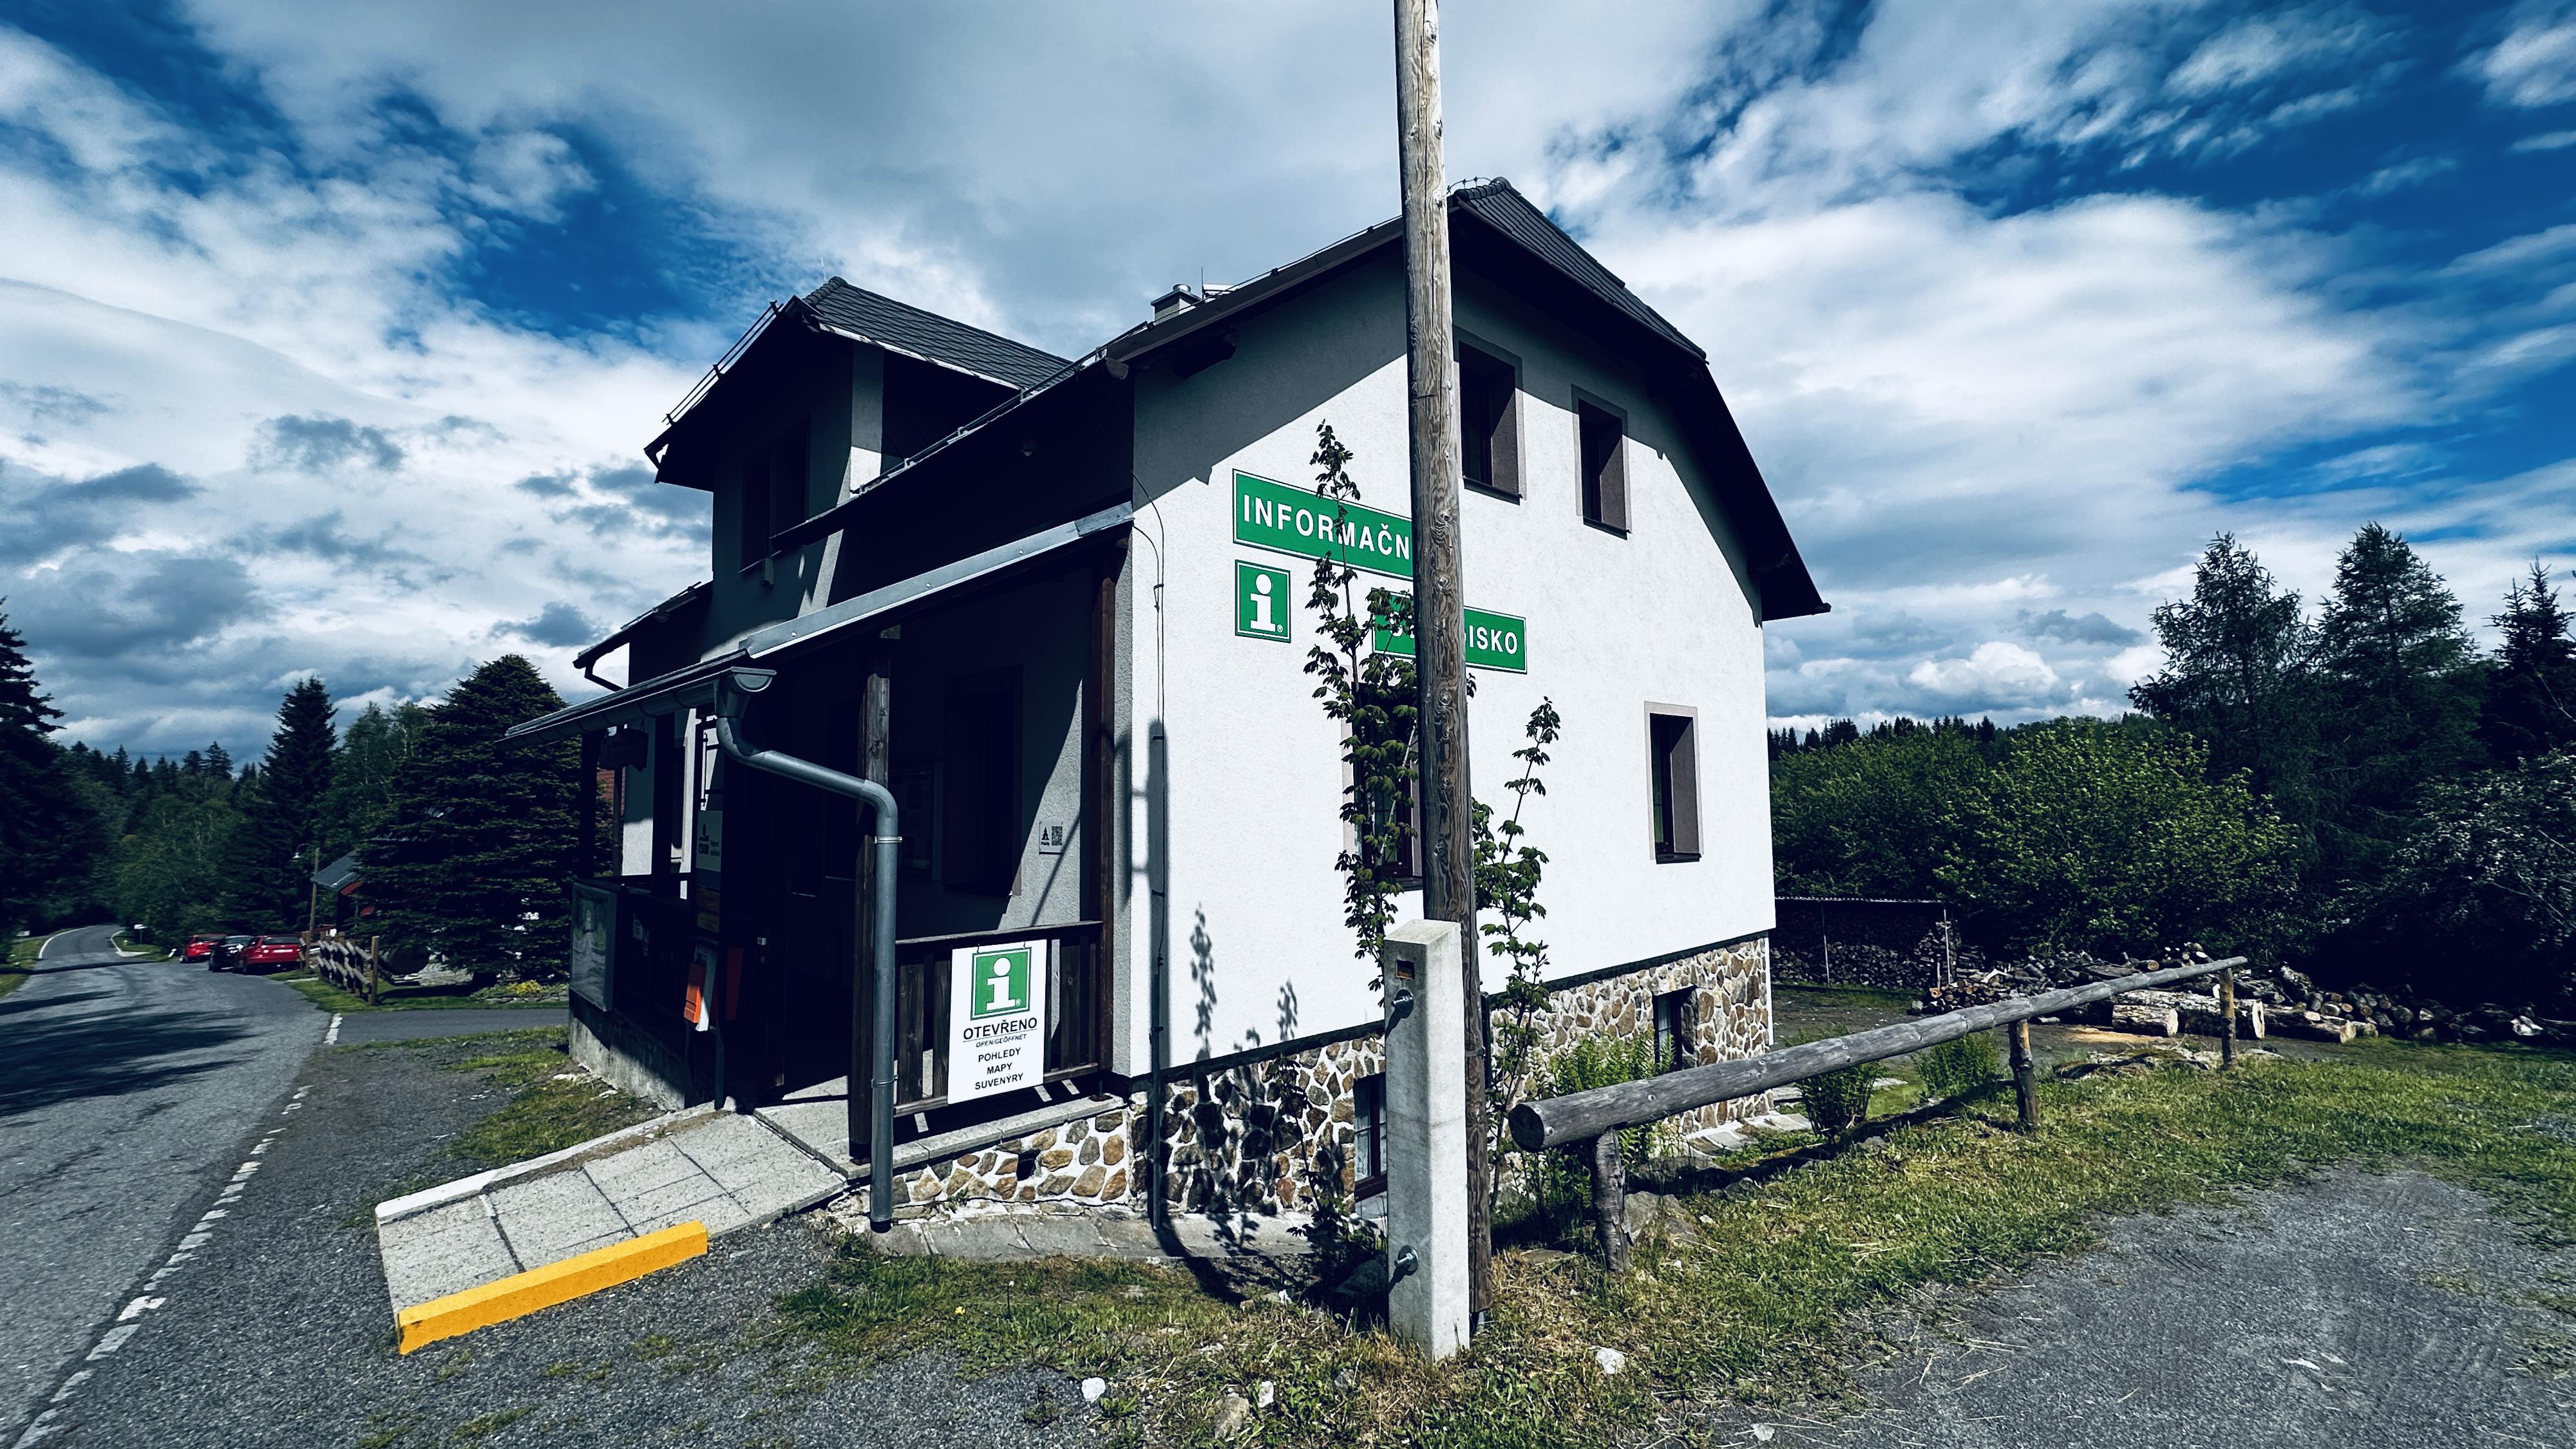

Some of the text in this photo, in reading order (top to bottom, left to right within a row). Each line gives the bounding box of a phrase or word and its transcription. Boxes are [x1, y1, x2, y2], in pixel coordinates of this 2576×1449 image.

[1244, 495, 1409, 560] INFORMAČN
[963, 1018, 1037, 1039] OTEVŘENO
[978, 1048, 1021, 1063] POHLEDY
[987, 1063, 1012, 1074] MAPY
